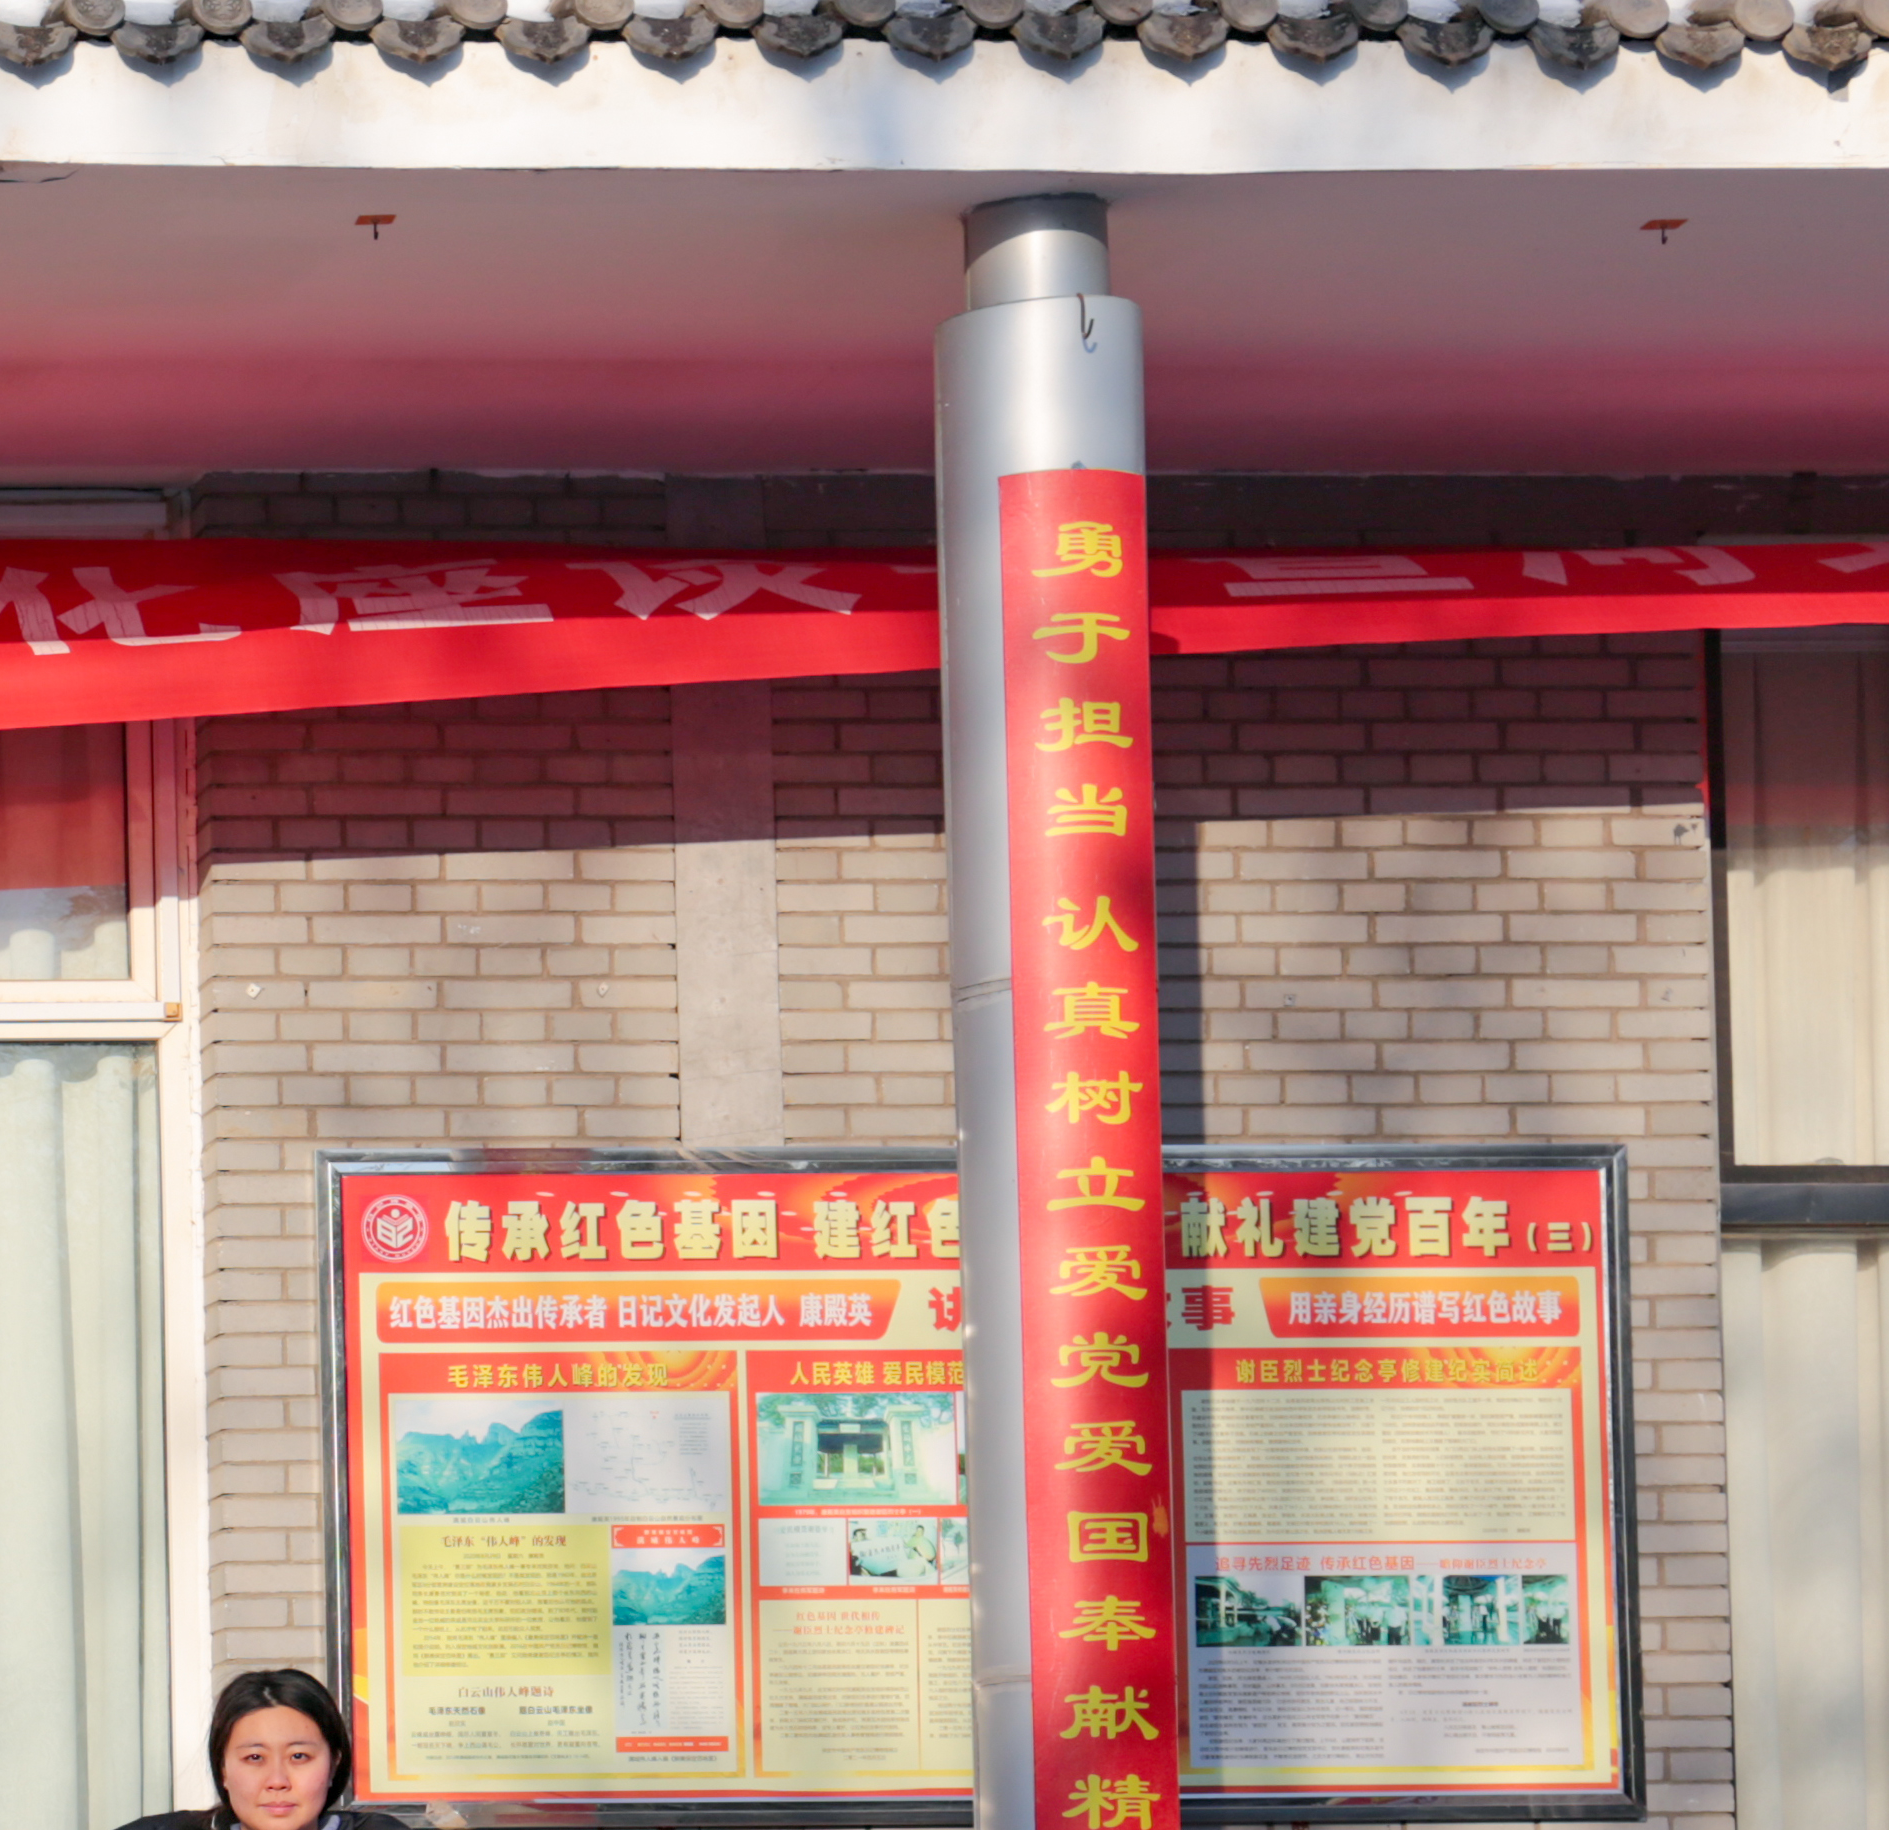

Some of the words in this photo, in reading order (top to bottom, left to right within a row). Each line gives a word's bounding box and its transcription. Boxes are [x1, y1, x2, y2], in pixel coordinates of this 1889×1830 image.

[1032, 521, 1134, 837] 勇于担当
[444, 1199, 778, 1261] 传承红色基因
[389, 1295, 607, 1331] 红色基因杰出传承者
[617, 1294, 786, 1329] 日记文化发起人
[799, 1293, 873, 1328] 康殿英
[1167, 1285, 1235, 1331] 事
[1288, 1290, 1563, 1327] 用亲身经历谱写红色故事
[447, 1363, 670, 1389] 毛泽东伟人峰的发现
[789, 1361, 876, 1386] 人民英雄
[1235, 1357, 1541, 1384] 谢臣烈士纪念亭修建纪实简述
